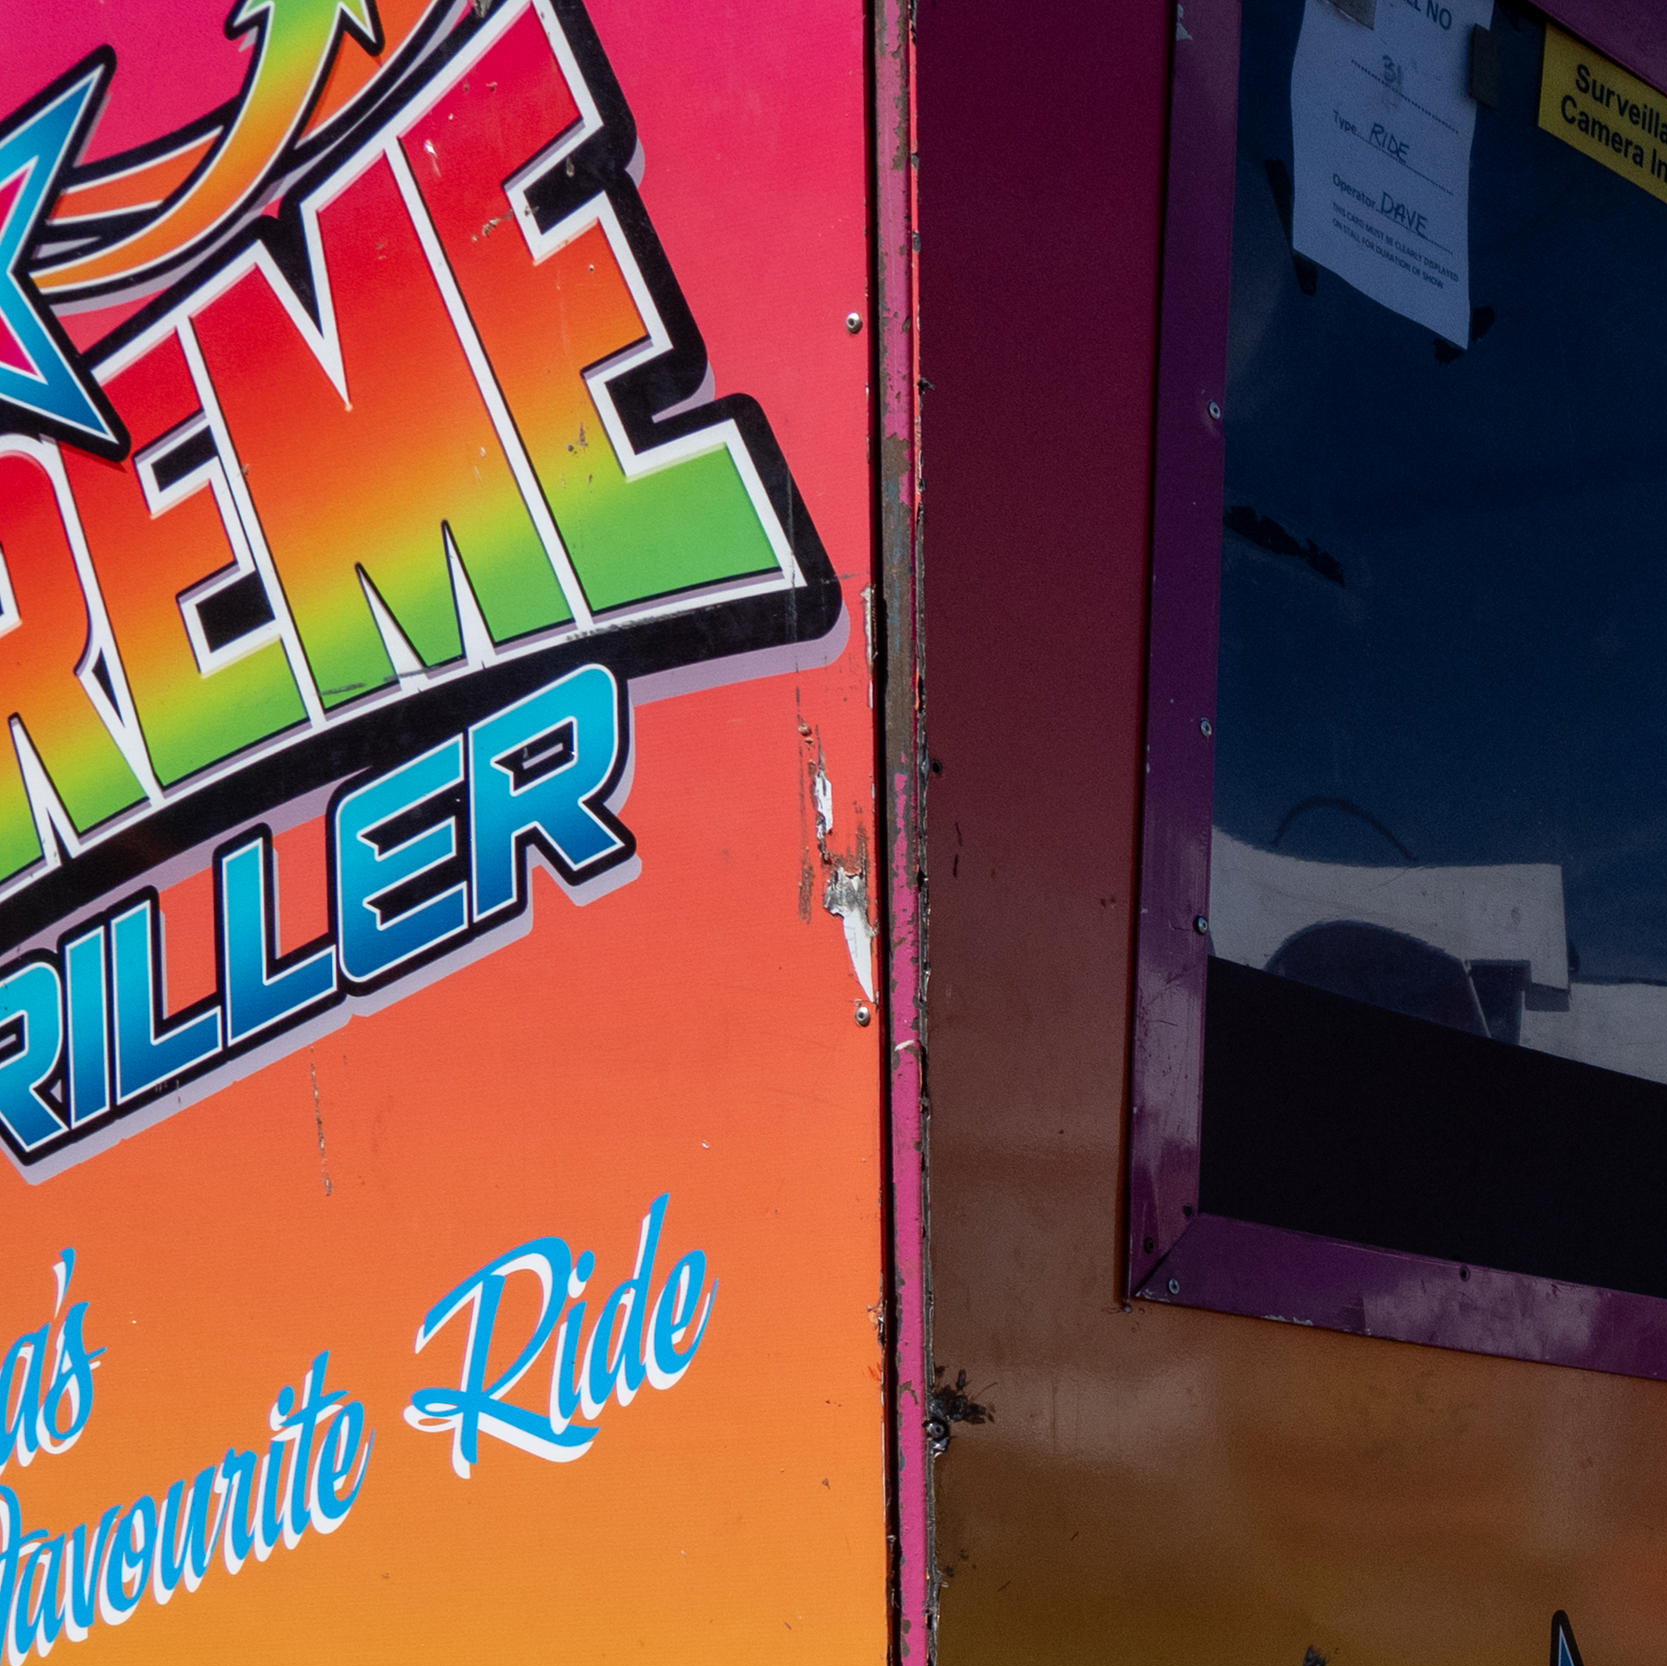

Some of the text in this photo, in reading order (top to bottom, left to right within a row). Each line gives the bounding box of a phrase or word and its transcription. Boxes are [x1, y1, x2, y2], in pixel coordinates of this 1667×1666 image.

[1333, 109, 1410, 164] Type RIDE
[1560, 94, 1644, 169] Camera
[1332, 172, 1430, 237] Operator DAVE
[403, 1190, 720, 1481] Ride
